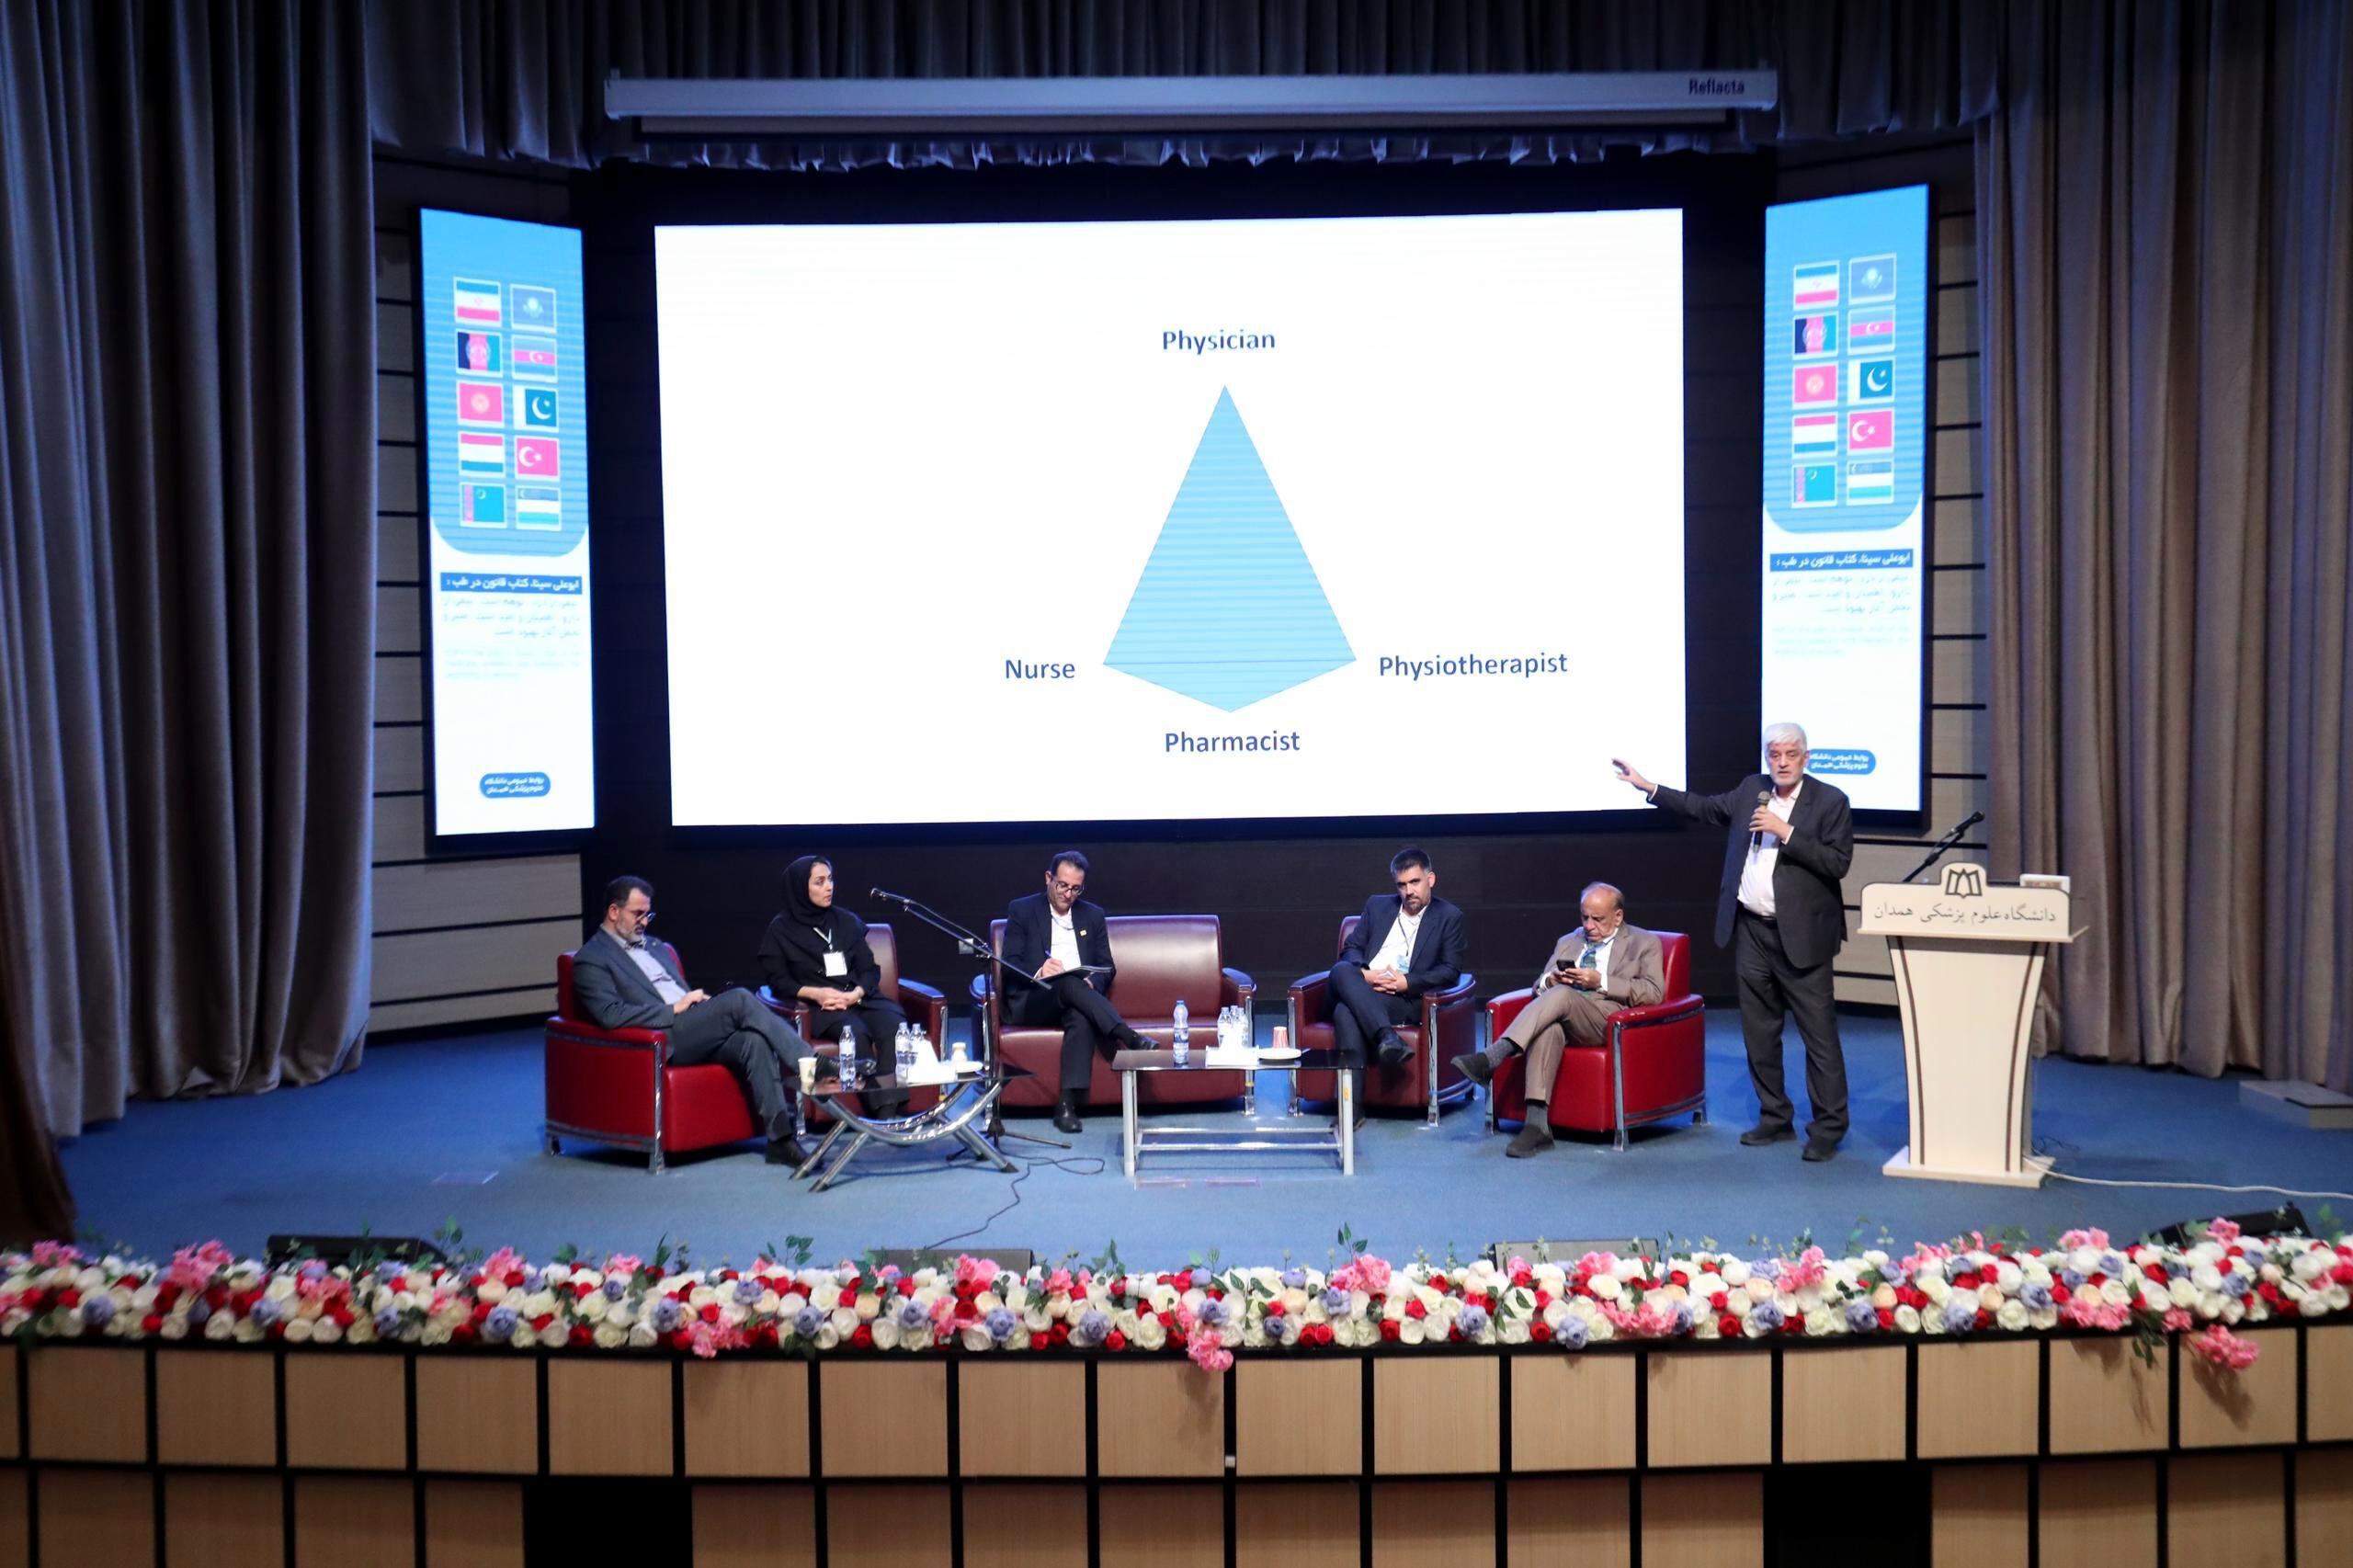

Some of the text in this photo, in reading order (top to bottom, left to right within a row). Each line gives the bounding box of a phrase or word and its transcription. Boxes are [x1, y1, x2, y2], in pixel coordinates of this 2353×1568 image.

[1164, 330, 1275, 355] Physician
[1799, 557, 1810, 568] در
[1811, 554, 1834, 567] قانون
[1836, 553, 1857, 566] کتاب
[1881, 551, 1911, 565] ابوعلی
[471, 579, 482, 589] در
[483, 577, 506, 589] قانون
[507, 578, 529, 590] کتاب
[552, 580, 579, 591] ابوعلی
[1006, 660, 1074, 678] Nurse
[1381, 653, 1567, 680] Physiotherapist
[1166, 731, 1300, 752] Pharmacist
[1874, 902, 2056, 926] دانشگاه علوم پزشکی همدان
